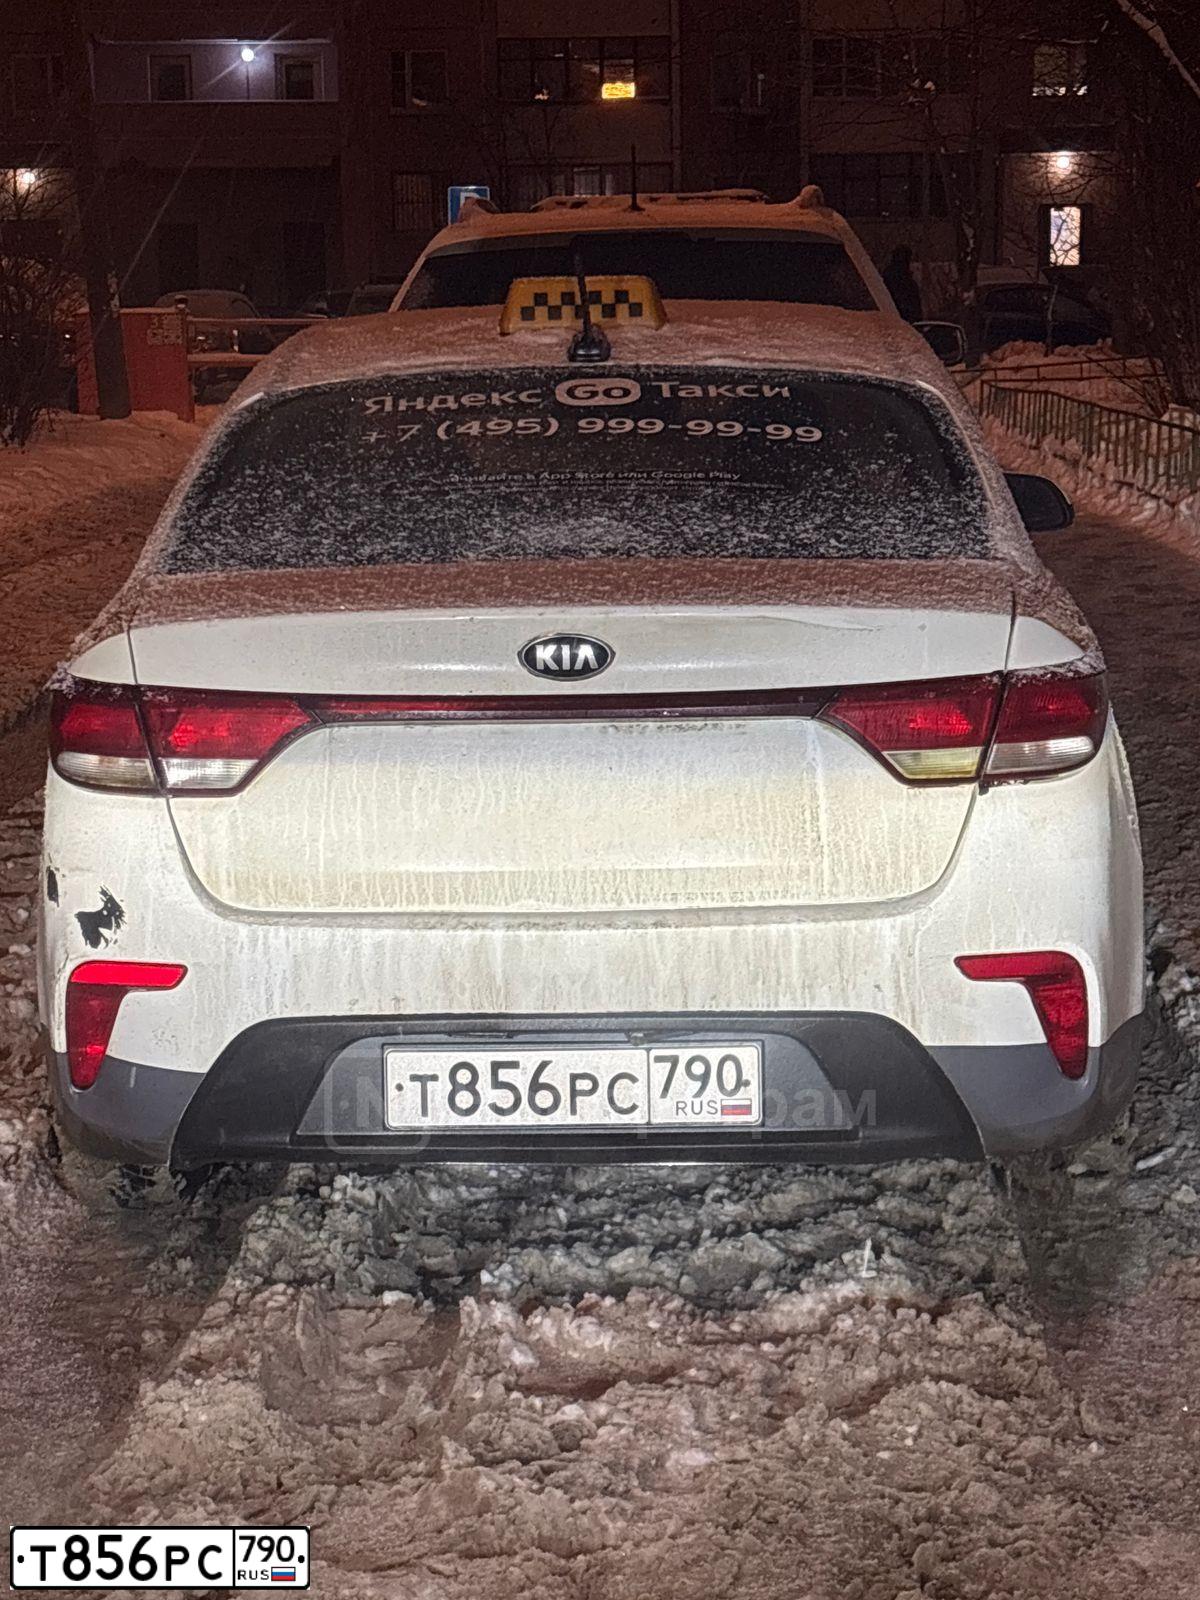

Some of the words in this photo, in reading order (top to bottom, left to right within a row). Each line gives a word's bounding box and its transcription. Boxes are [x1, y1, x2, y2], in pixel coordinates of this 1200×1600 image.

[364, 389, 542, 415] Яндекс
[652, 381, 790, 398] Такси
[436, 417, 559, 441] (495)
[577, 418, 823, 443] 999-99-99
[539, 471, 572, 480] App
[618, 472, 648, 480] или
[651, 470, 705, 480] Google
[709, 470, 742, 481] Play
[535, 644, 599, 671] KIA
[653, 1053, 743, 1099] 790
[675, 1100, 719, 1117] RUS
